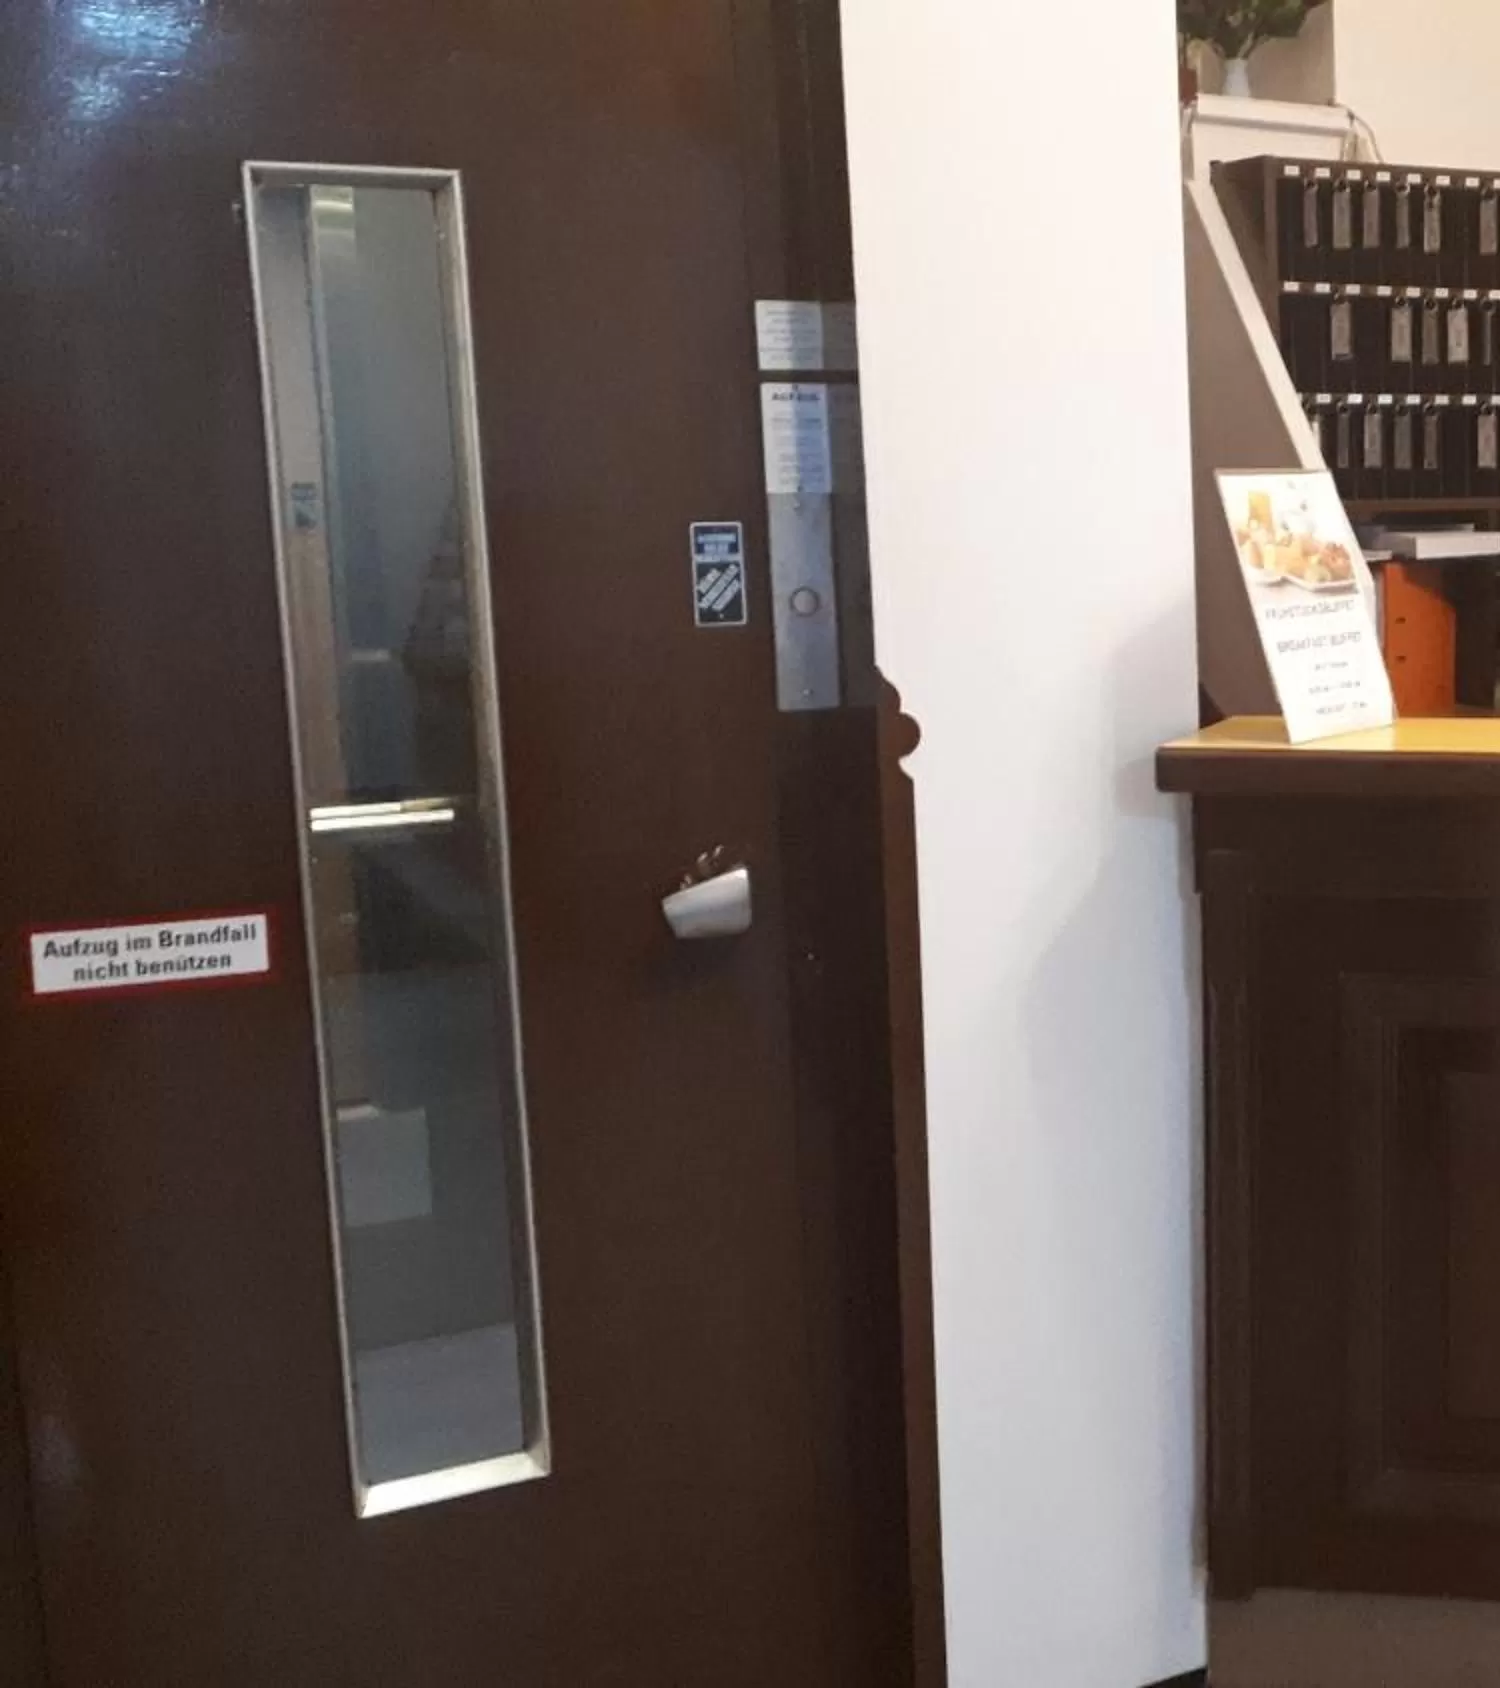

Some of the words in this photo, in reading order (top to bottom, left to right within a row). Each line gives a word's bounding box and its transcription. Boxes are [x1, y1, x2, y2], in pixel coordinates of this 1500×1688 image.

[43, 938, 119, 958] Aufzug
[126, 932, 152, 950] im
[158, 923, 257, 948] Brandfall
[73, 961, 129, 982] nicht
[135, 951, 232, 975] benützen
